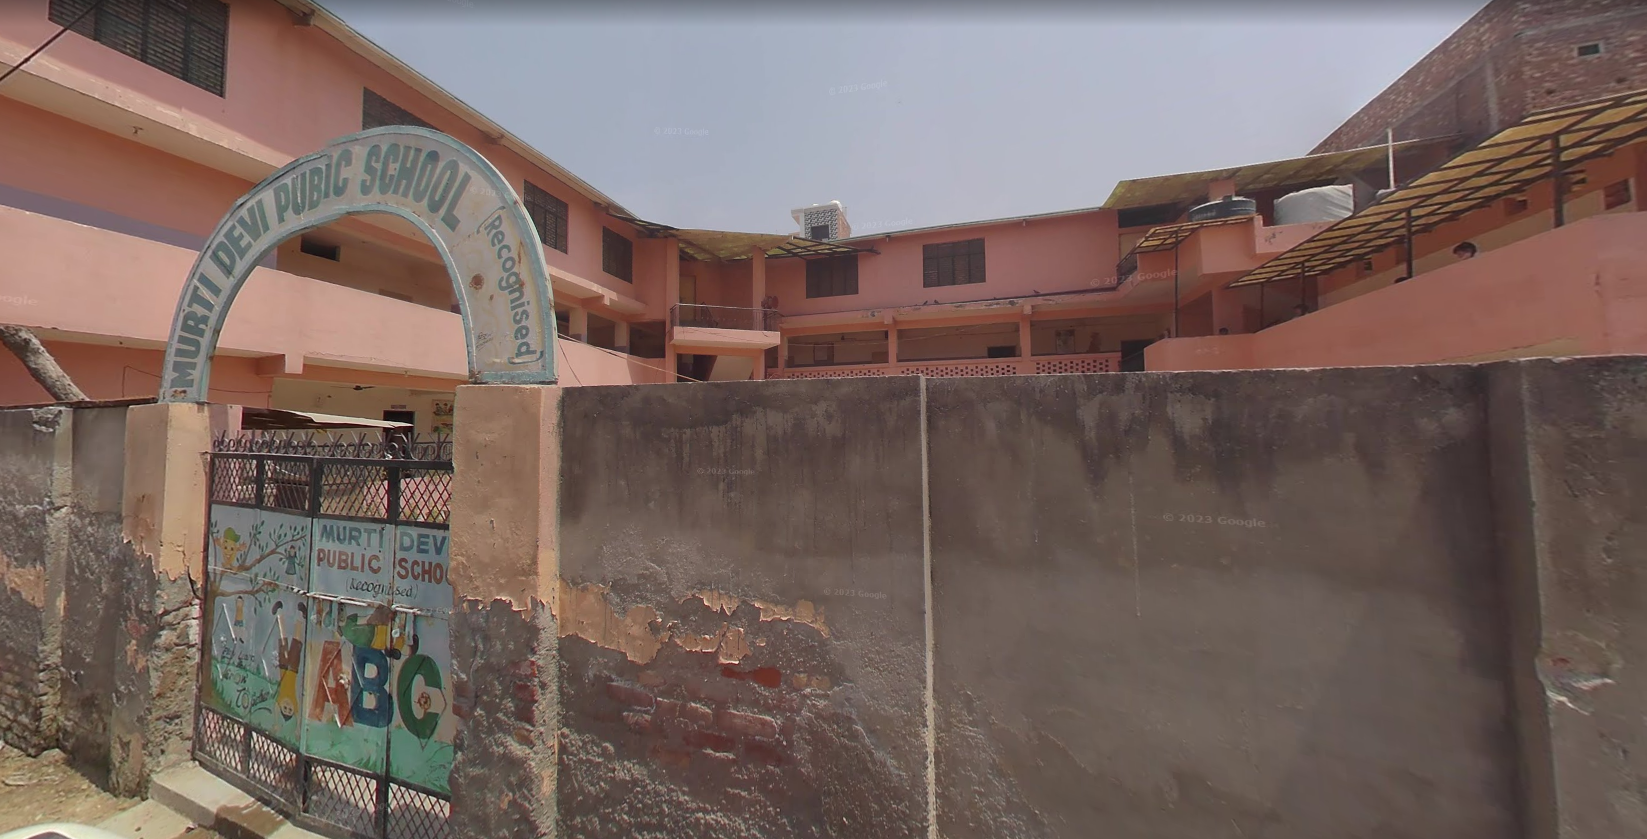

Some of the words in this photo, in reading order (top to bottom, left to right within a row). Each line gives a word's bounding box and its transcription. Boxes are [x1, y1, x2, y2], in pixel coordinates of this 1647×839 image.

[169, 271, 222, 388] MURTI
[209, 198, 270, 280] DEVI
[273, 149, 352, 225] PUBIC
[360, 143, 472, 232] SCHOOL
[476, 205, 544, 365] (Recognised)
[321, 525, 384, 549] MURTI
[399, 531, 450, 556] DEV
[316, 548, 382, 575] PUBLIC
